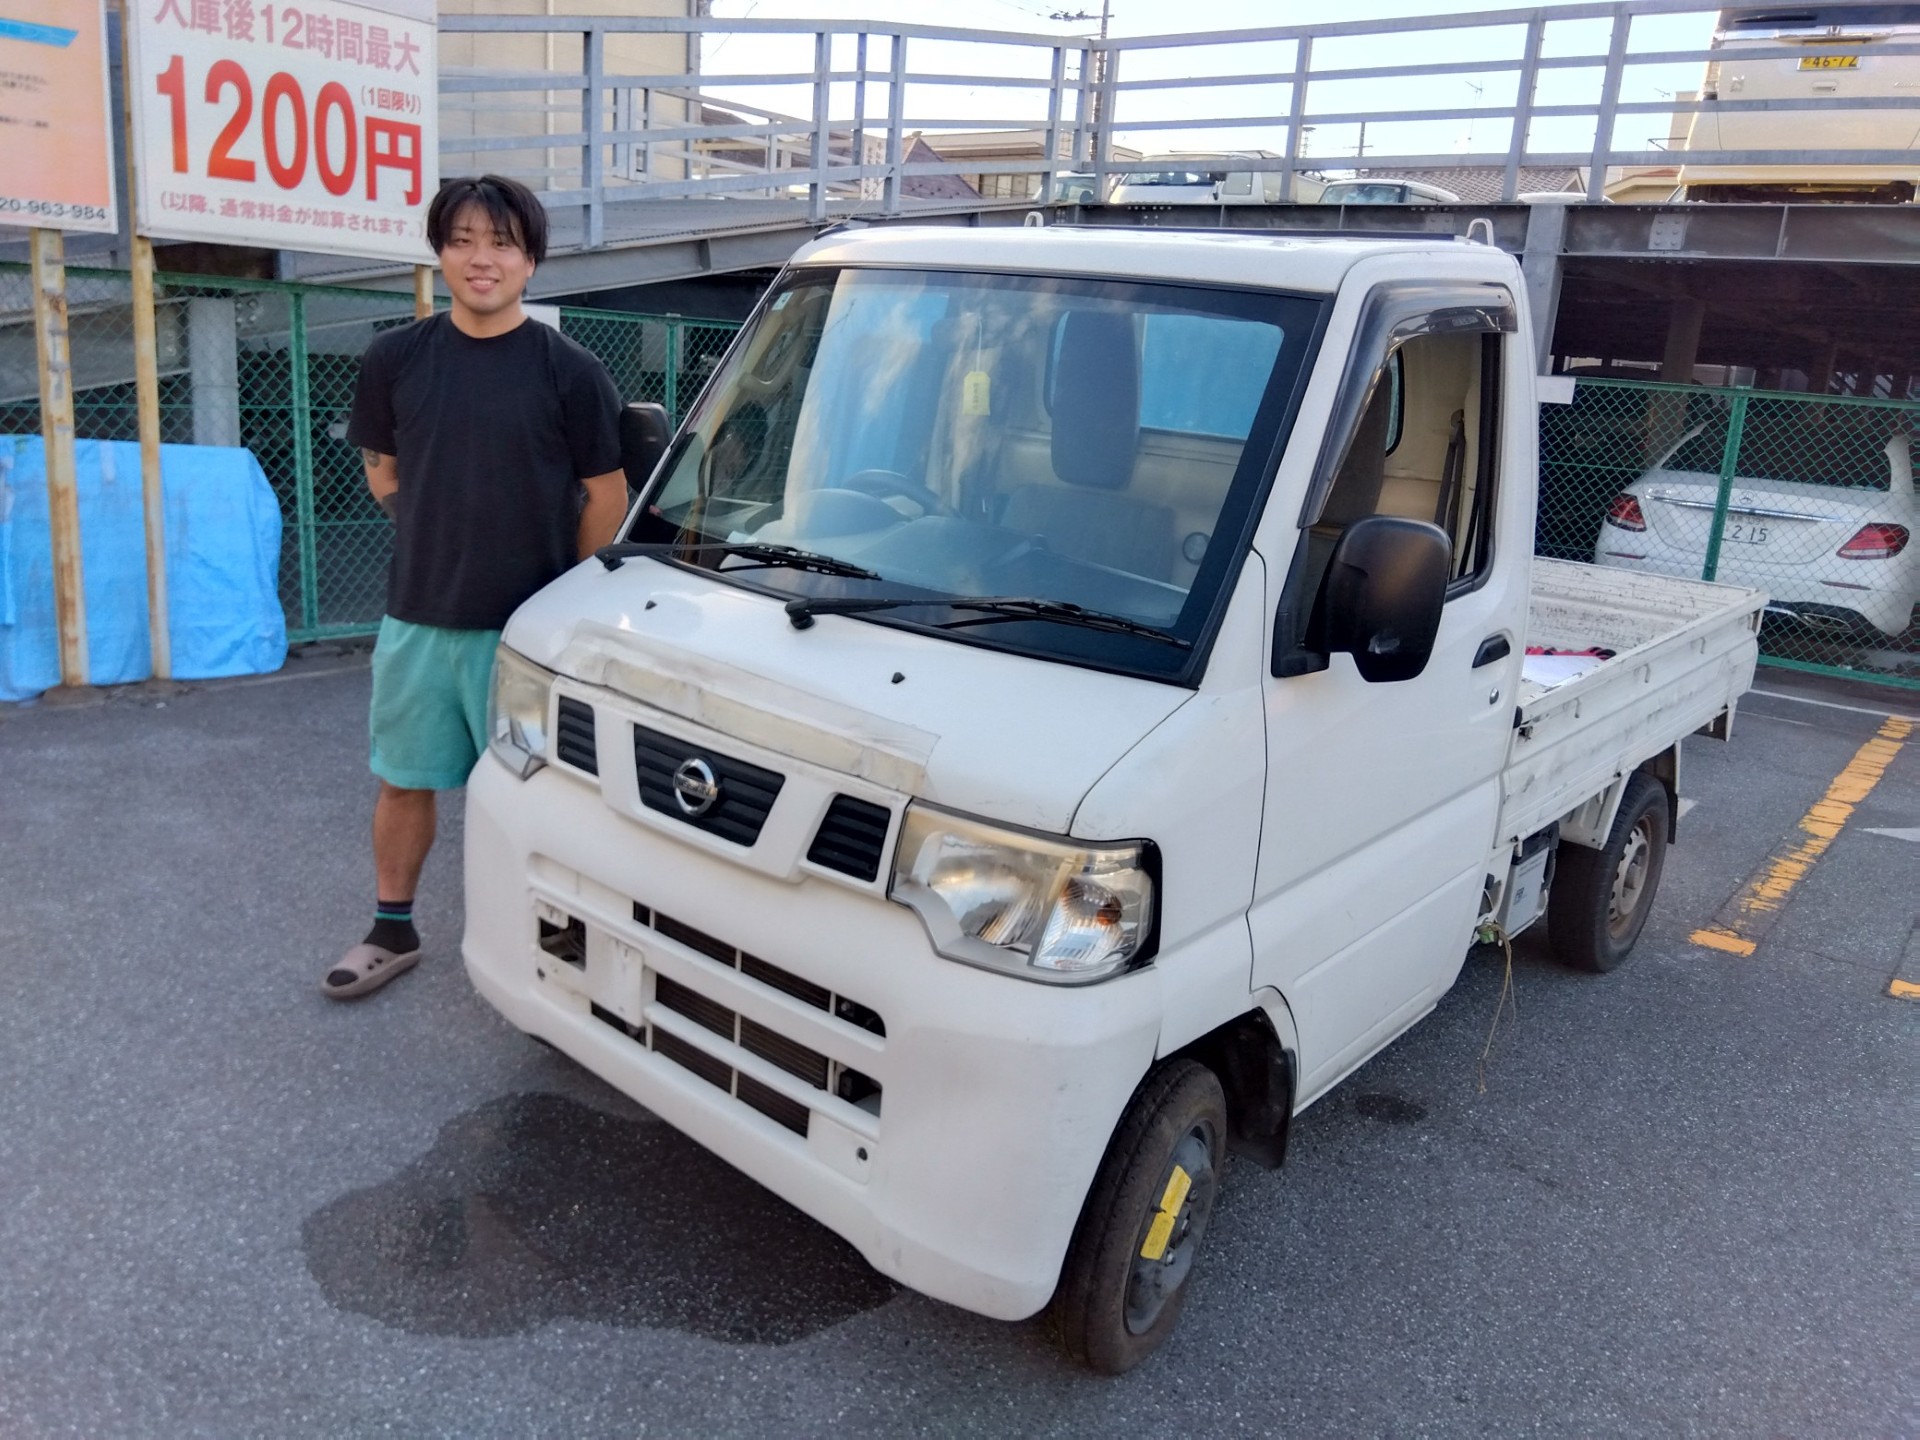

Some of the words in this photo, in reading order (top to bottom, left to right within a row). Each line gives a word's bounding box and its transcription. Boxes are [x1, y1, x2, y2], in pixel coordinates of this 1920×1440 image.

[154, 0, 420, 76] 入庫後12時間最大
[156, 54, 422, 207] 1200円
[361, 85, 421, 115] (1回限り)
